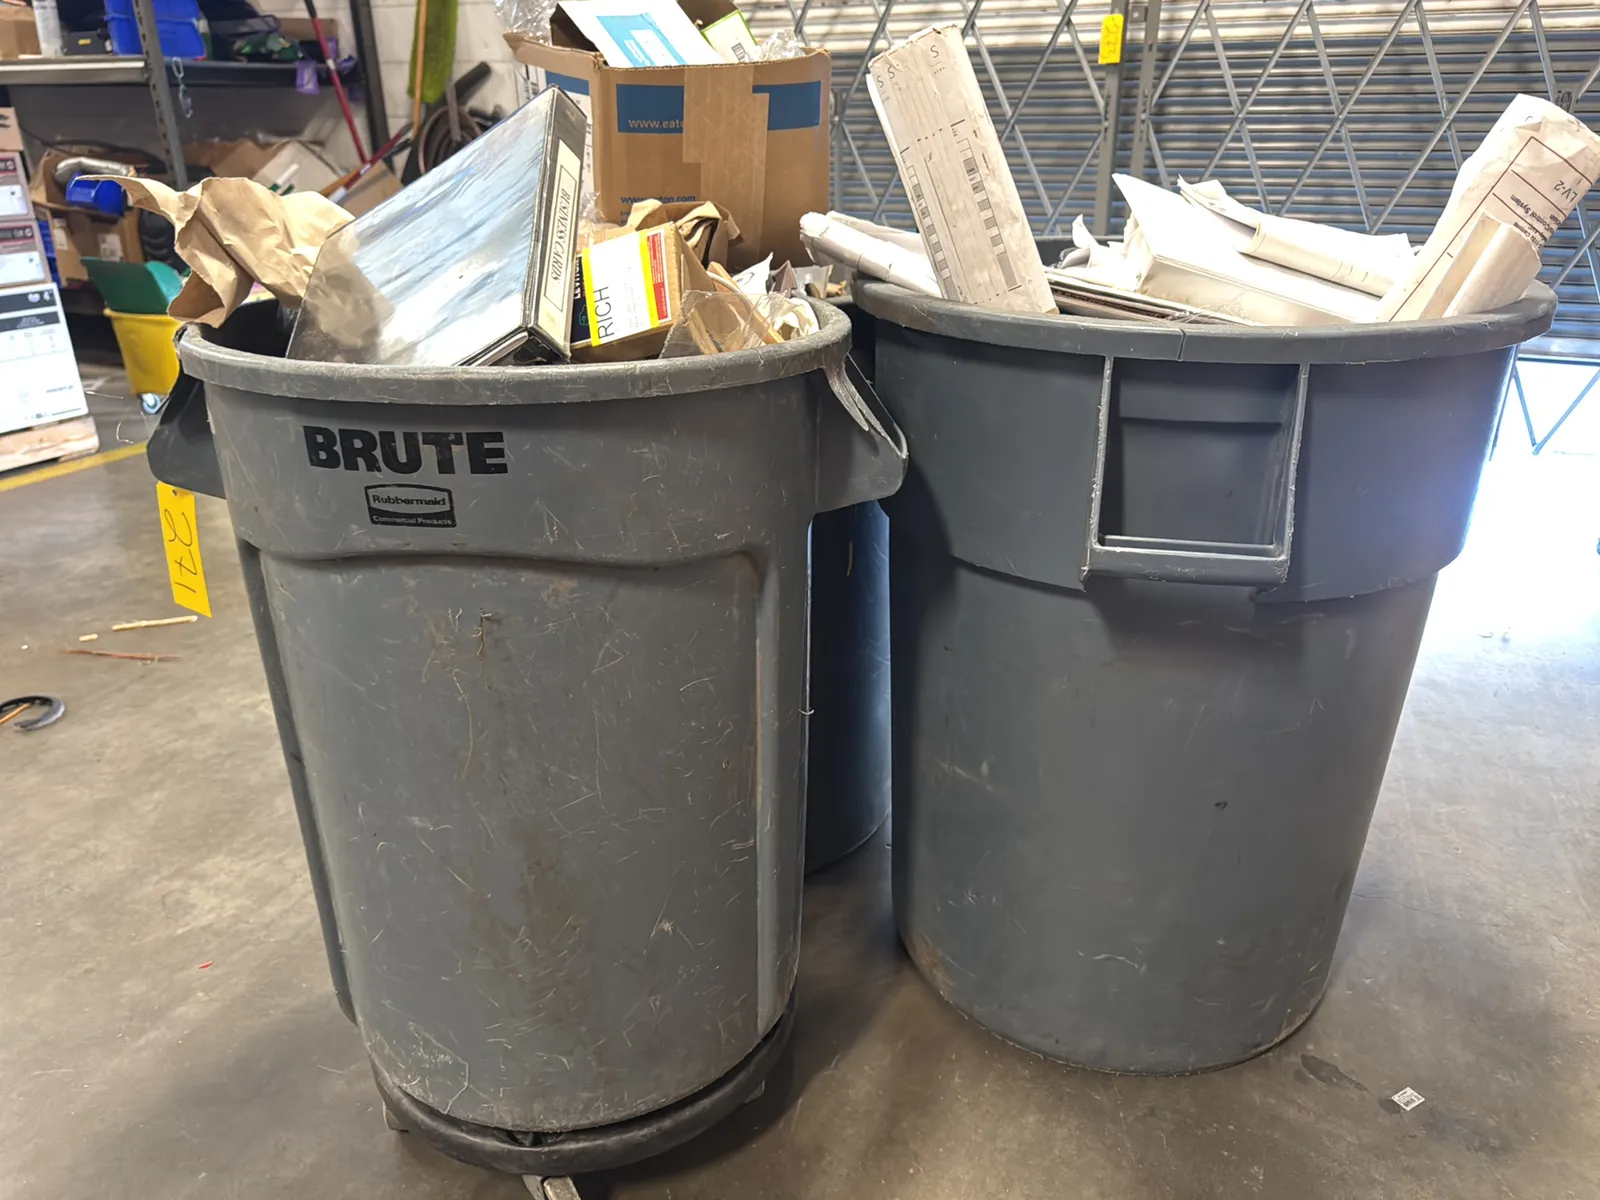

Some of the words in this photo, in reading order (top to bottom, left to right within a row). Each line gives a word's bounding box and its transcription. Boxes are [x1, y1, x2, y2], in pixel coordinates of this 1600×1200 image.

[1510, 194, 1531, 215] System
[1553, 179, 1578, 203] LV-2
[556, 187, 571, 243] BUSINESS
[550, 241, 565, 281] CARDS
[593, 286, 614, 339] RICH
[303, 425, 508, 475] BRUTE
[372, 494, 446, 506] Rubbermaid
[372, 515, 416, 524] Commercial
[417, 517, 452, 526] Products
[164, 508, 198, 593] 271
